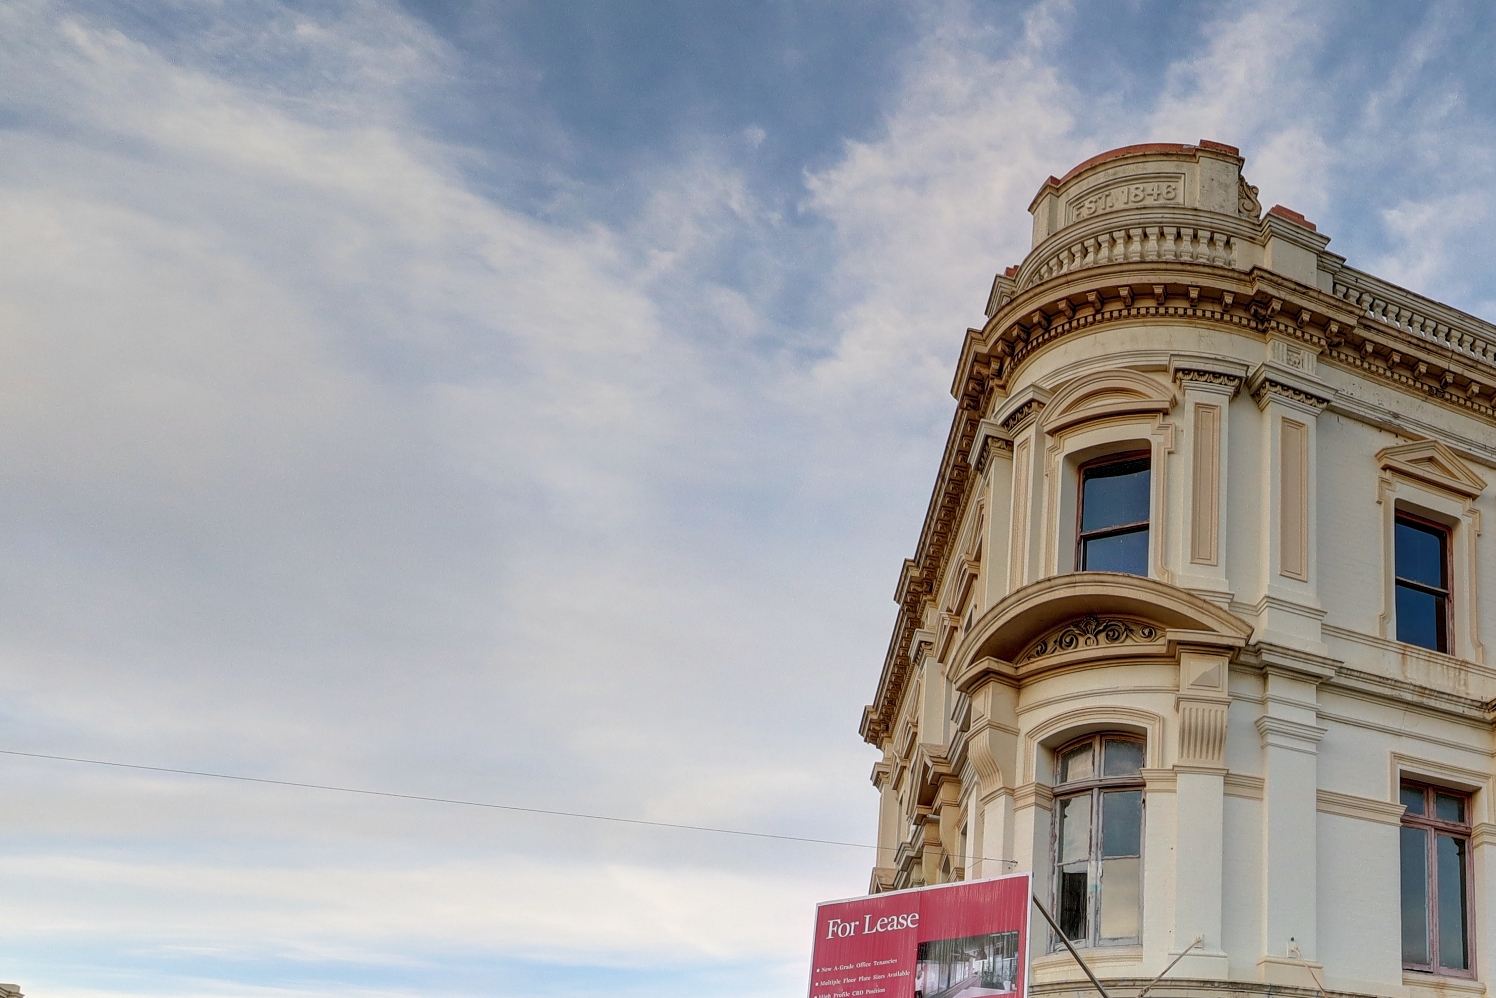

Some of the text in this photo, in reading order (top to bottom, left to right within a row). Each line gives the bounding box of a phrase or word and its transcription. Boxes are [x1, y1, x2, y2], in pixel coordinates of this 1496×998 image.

[1075, 183, 1177, 219] EST. 1846
[826, 912, 920, 940] For Lease
[833, 963, 855, 971] A-Grade
[873, 958, 898, 966] Tenancies
[820, 978, 841, 986] Multiple
[887, 969, 911, 978] Available
[833, 991, 850, 998] Profile
